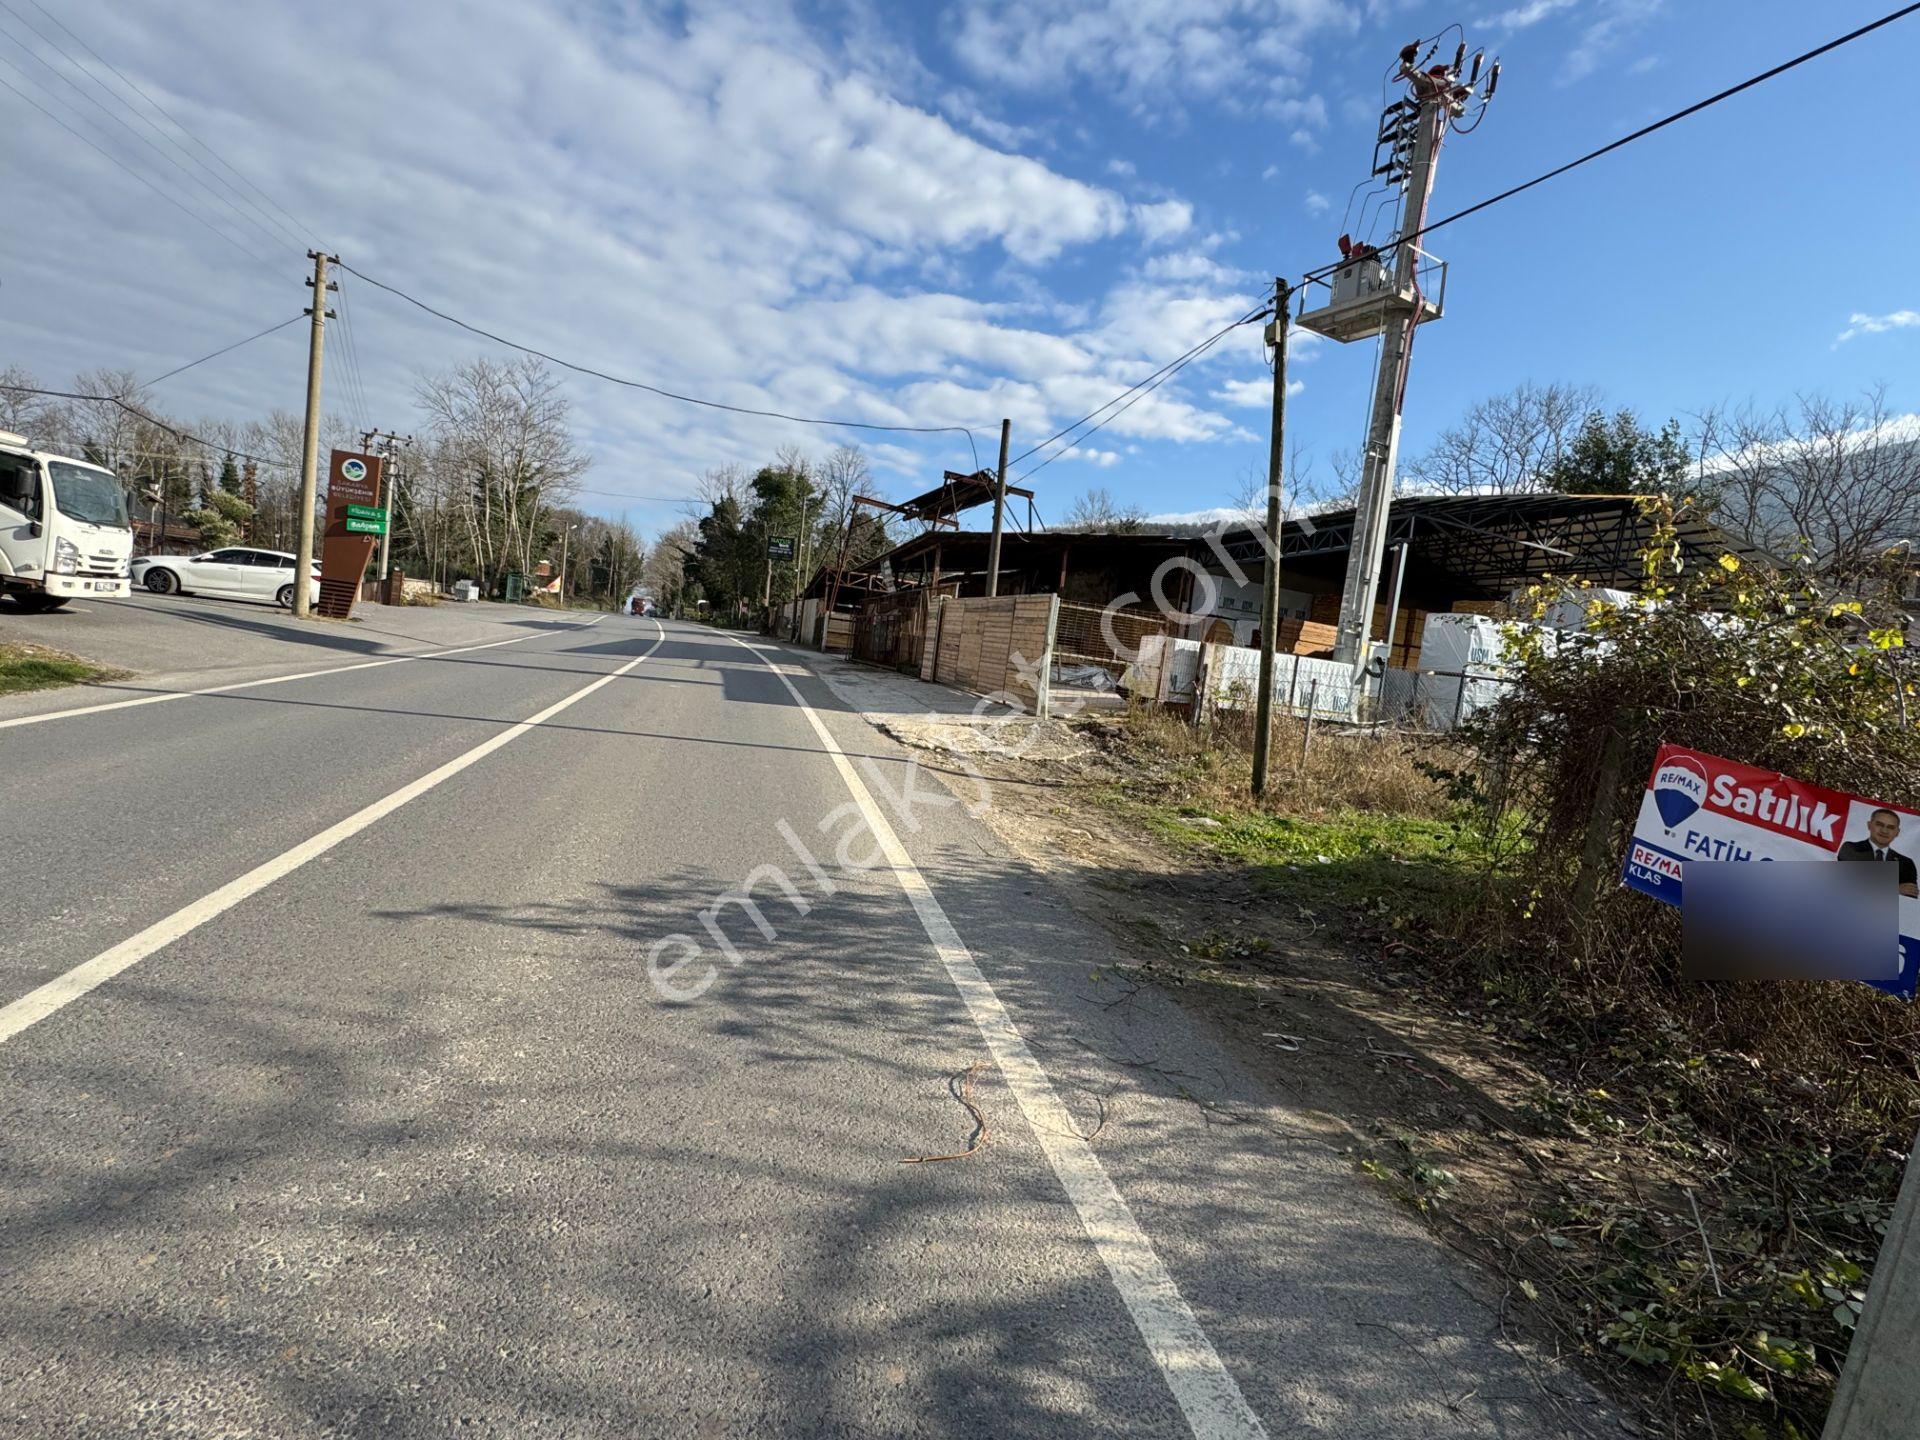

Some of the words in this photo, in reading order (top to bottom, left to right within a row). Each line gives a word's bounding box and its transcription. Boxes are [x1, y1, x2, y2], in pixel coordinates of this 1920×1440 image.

[1660, 773, 1702, 795] RE/MAX
[1709, 774, 1842, 843] Satılık
[1628, 864, 1662, 886] KLAS
[1634, 848, 1682, 879] RE/MA
